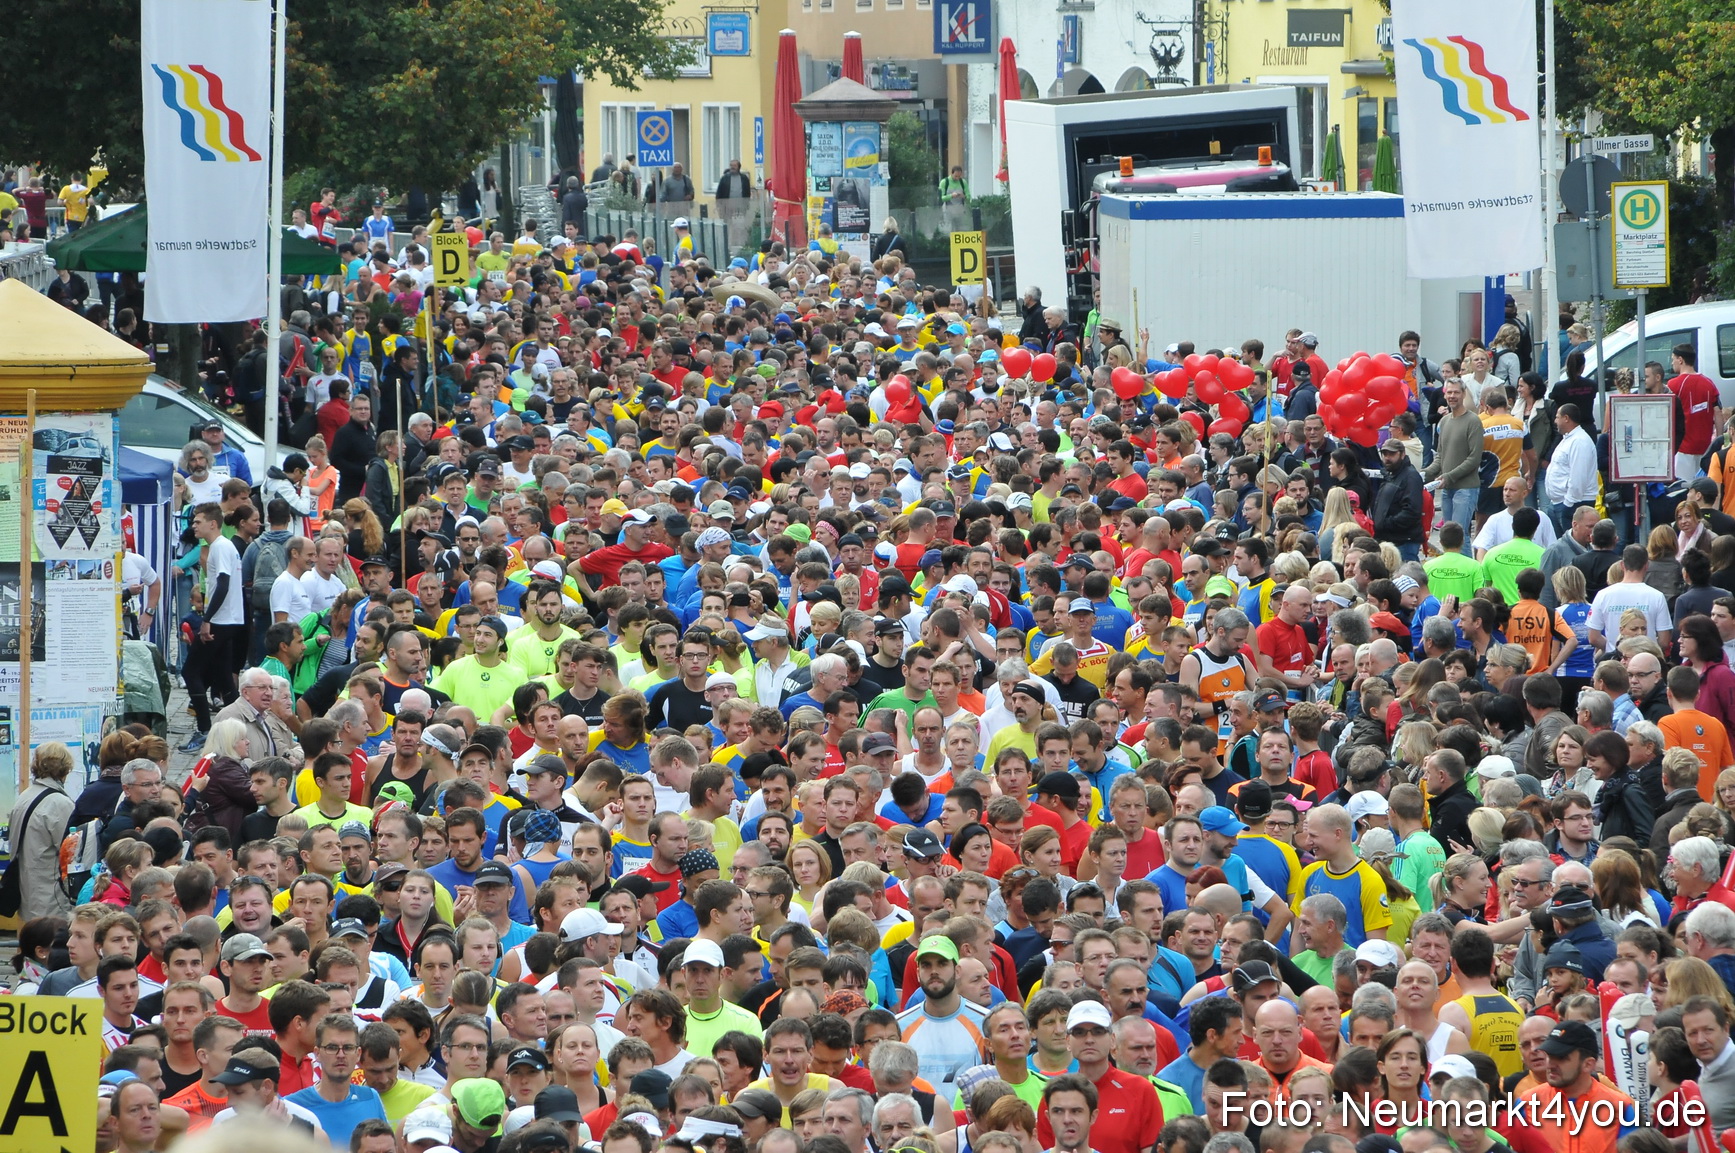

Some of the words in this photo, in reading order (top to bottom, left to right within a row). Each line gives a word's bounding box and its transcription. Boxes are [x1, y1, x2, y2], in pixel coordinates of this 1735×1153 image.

[1291, 33, 1341, 42] TAIFUN
[1596, 140, 1621, 151] Ulmer
[1624, 139, 1649, 149] Gasse
[641, 150, 670, 162] TAXI
[1630, 198, 1650, 221] H
[436, 235, 464, 245] Block
[954, 234, 982, 244] Block
[1623, 233, 1658, 241] Marktplatz
[442, 249, 460, 275] D
[960, 248, 978, 273] D
[1514, 616, 1545, 631] TSV
[0, 1003, 88, 1035] Block
[1492, 1034, 1513, 1043] Team
[1621, 1047, 1634, 1081] BMW
[0, 1051, 69, 1136] A
